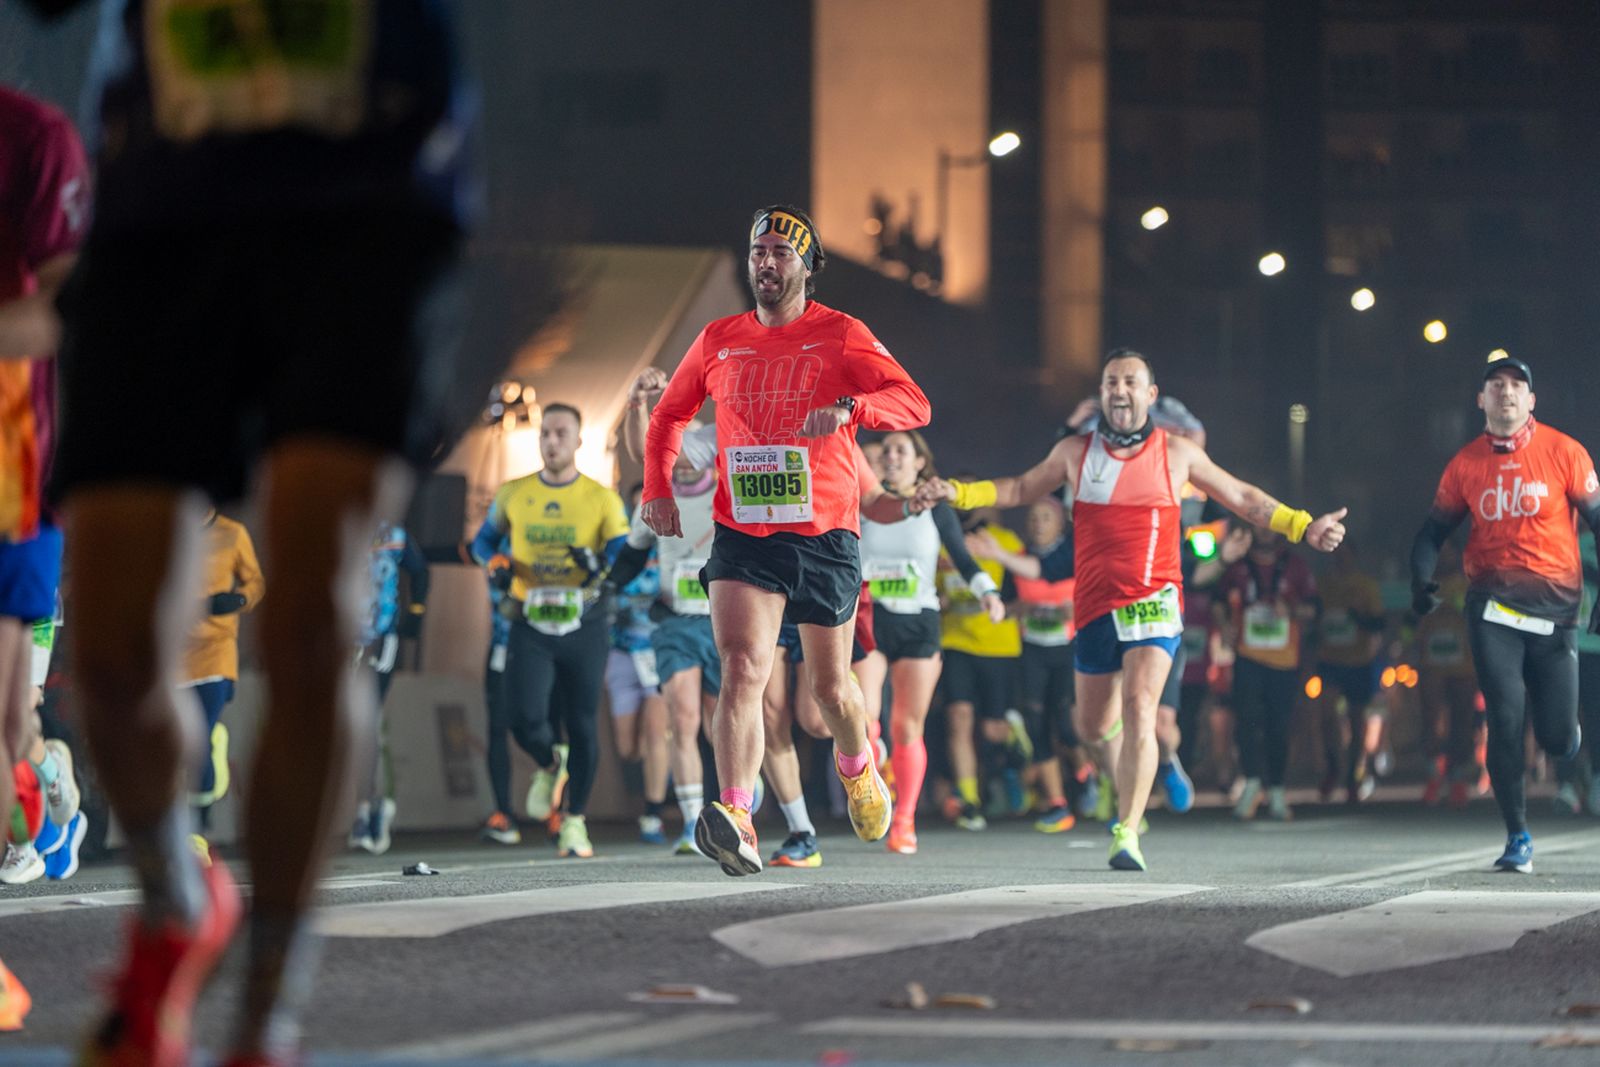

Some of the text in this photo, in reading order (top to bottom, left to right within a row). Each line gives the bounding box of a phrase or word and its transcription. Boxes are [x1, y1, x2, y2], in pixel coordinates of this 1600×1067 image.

[744, 455, 767, 463] NOCHE
[736, 465, 751, 473] SAN
[751, 463, 778, 473] ANTÓN
[738, 473, 801, 497] 13095
